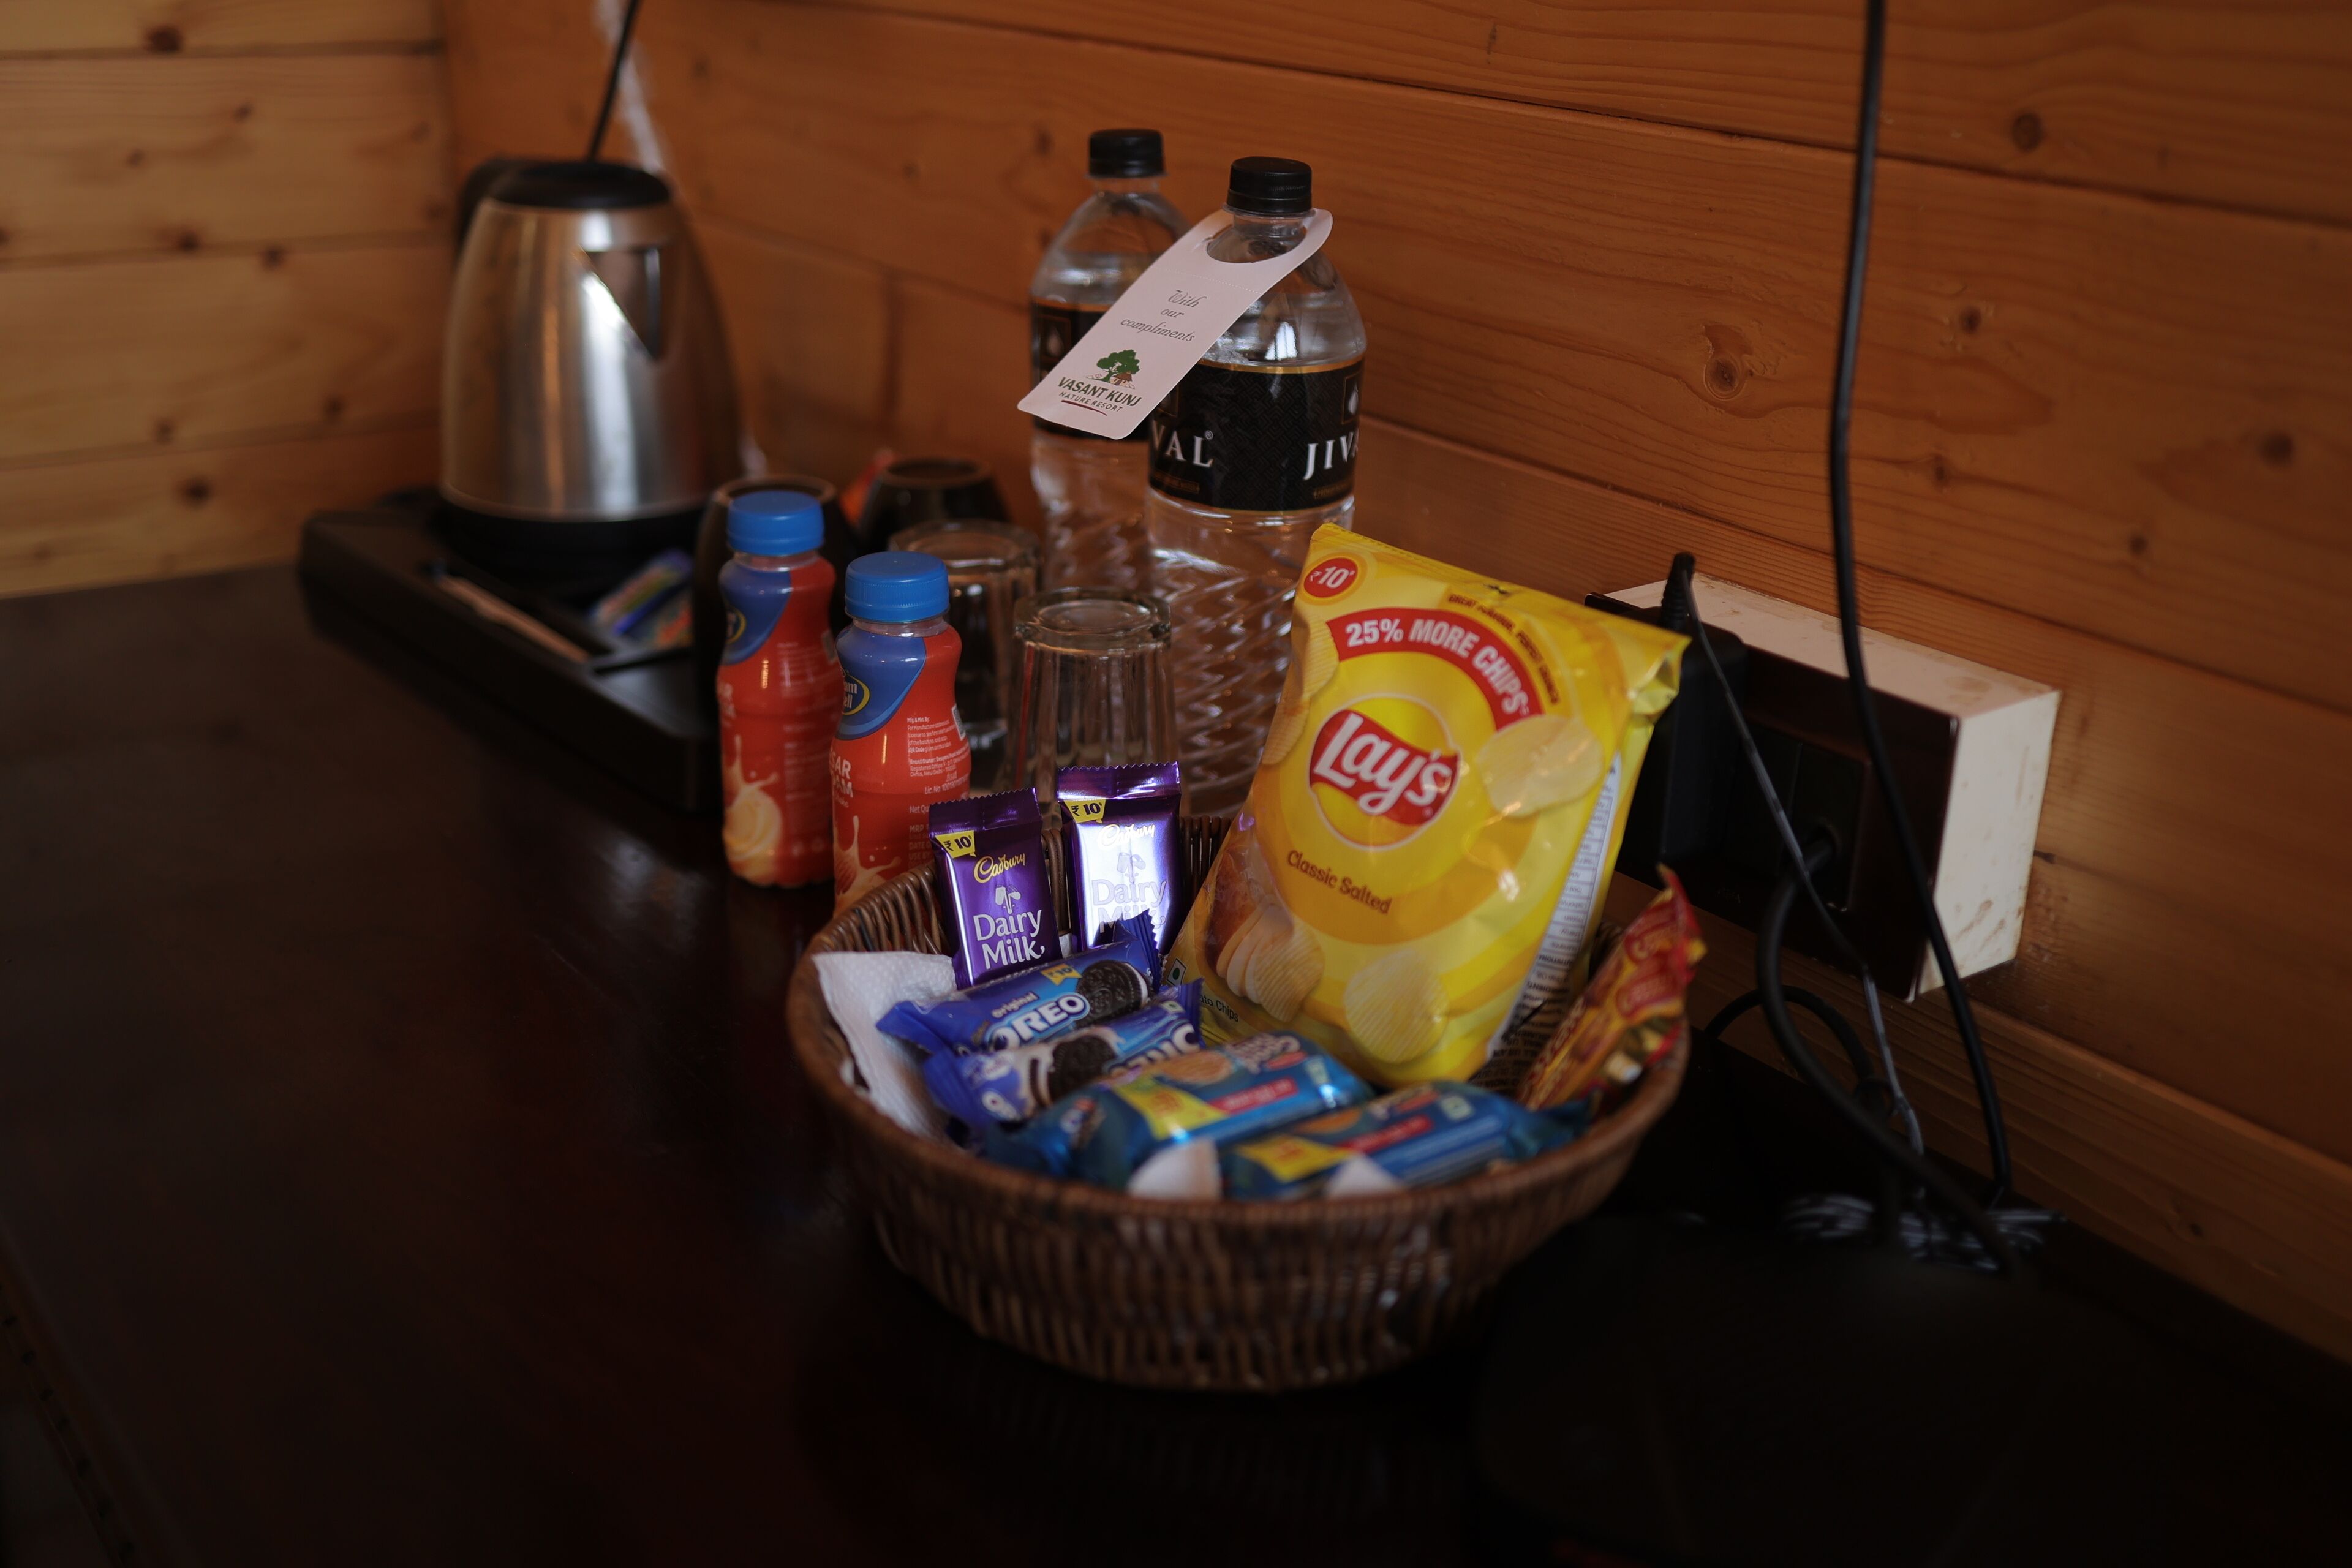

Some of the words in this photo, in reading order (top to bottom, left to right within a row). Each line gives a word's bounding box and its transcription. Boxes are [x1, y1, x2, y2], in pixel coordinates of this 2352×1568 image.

[1168, 289, 1207, 307] With
[1161, 309, 1185, 318] our
[1120, 319, 1196, 342] compliments
[1058, 377, 1108, 398] VASANT
[1105, 390, 1142, 407] KUNJ
[1059, 391, 1091, 404] NATURE
[1091, 401, 1123, 412] RESORT
[1345, 617, 1404, 648] 25%
[1408, 618, 1481, 659] MORE
[1313, 712, 1453, 815] Lay's
[1098, 824, 1155, 850] Cadbury
[974, 853, 1025, 883] Cadbury
[1287, 850, 1338, 888] Classic
[1340, 876, 1393, 915] Salted
[1091, 879, 1167, 908] Dairy
[973, 909, 1042, 941] Dairy
[982, 935, 1046, 970] Milk
[987, 995, 1086, 1052] OREO
[1216, 1000, 1239, 1022] Chips
